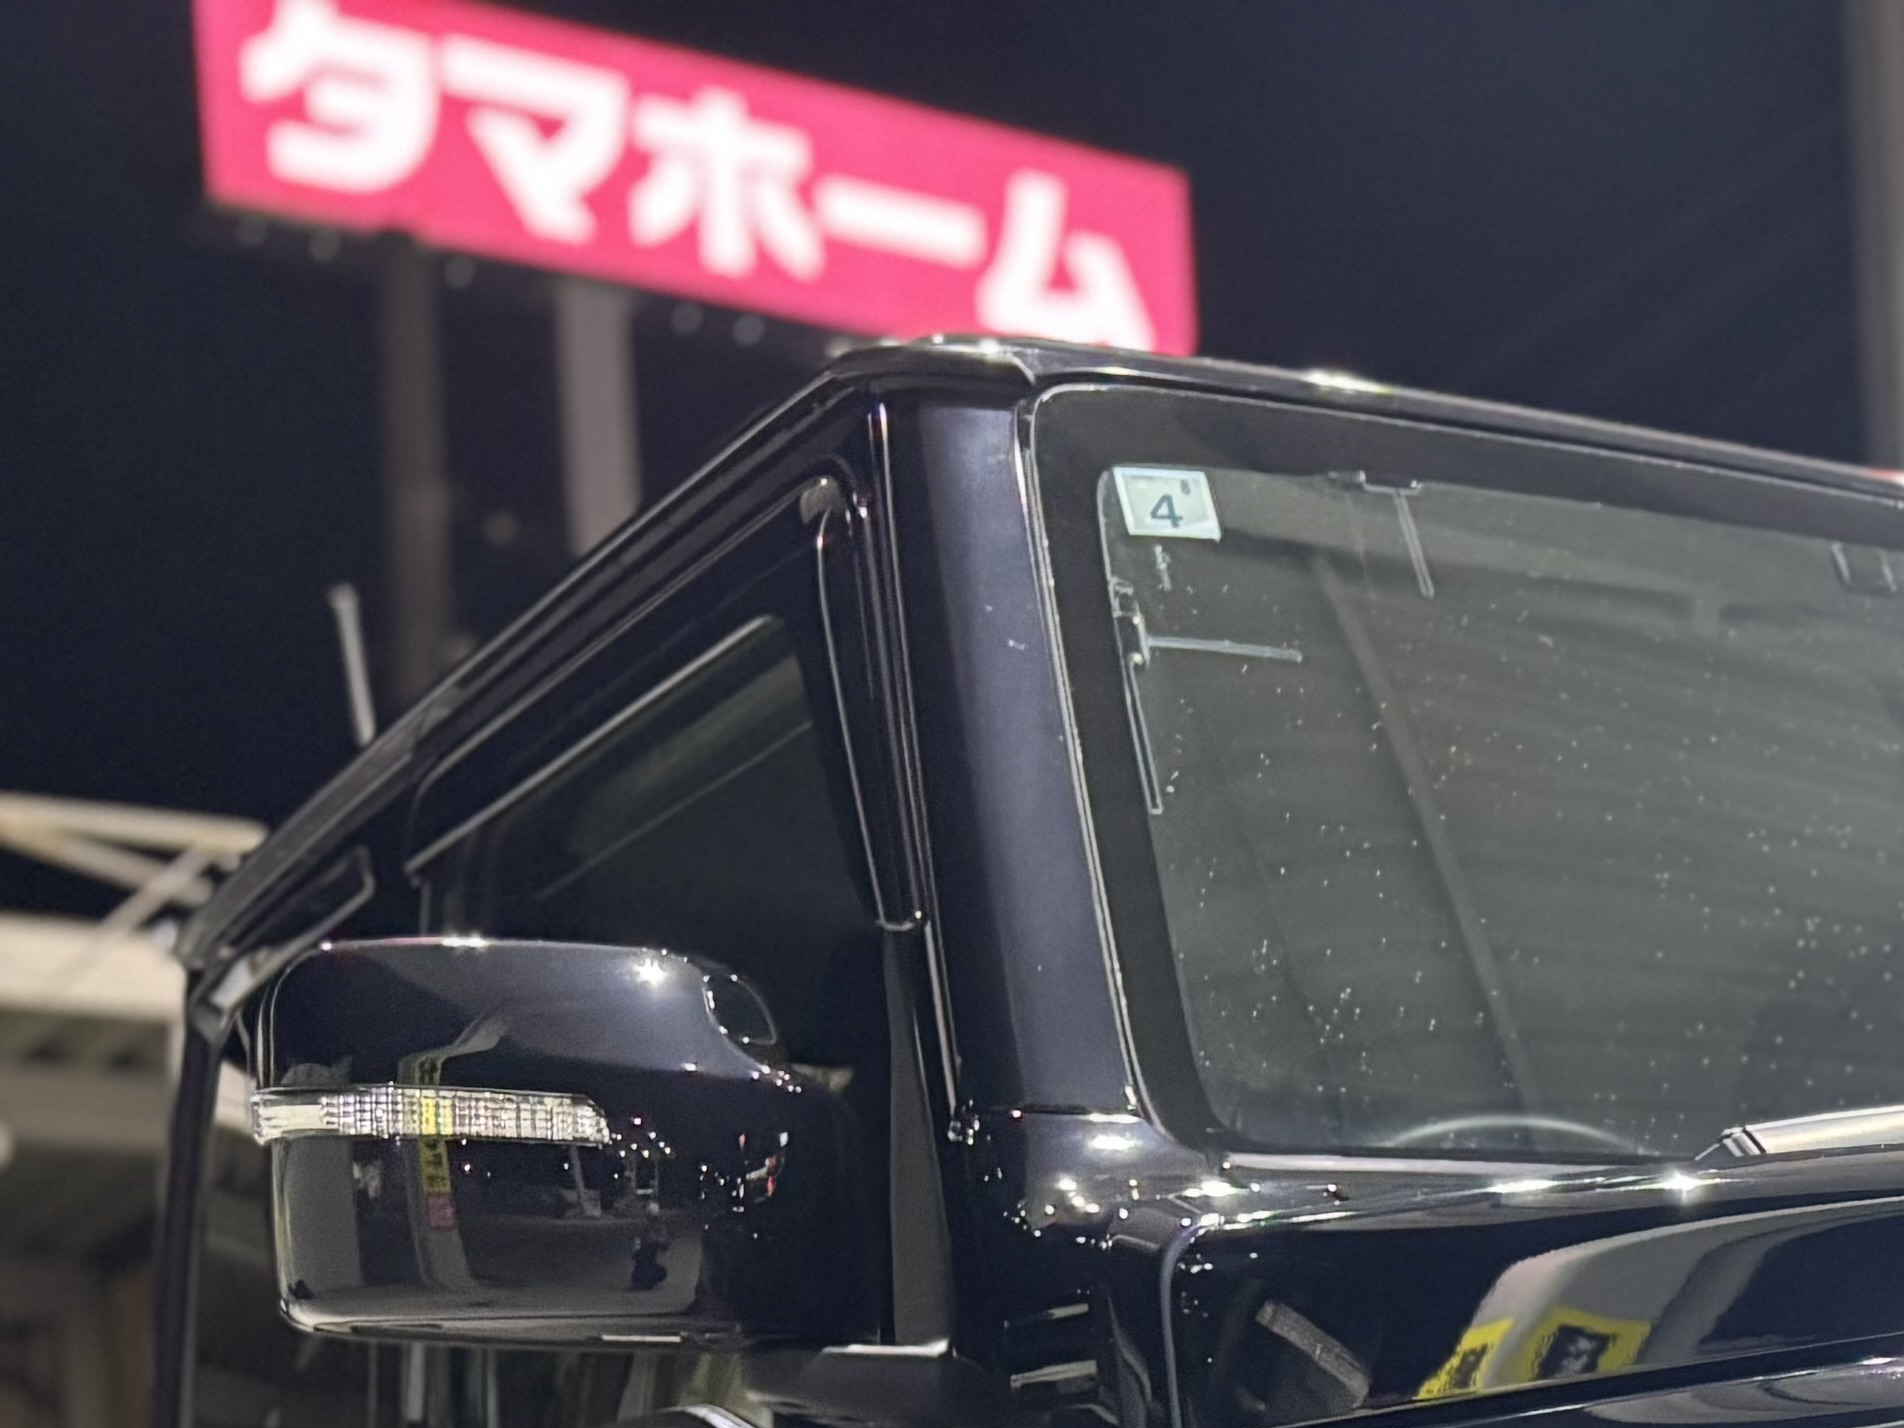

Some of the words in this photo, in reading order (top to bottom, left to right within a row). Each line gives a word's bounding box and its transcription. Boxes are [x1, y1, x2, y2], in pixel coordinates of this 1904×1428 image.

[238, 0, 1155, 350] タマホーム
[1150, 494, 1184, 529] 4
